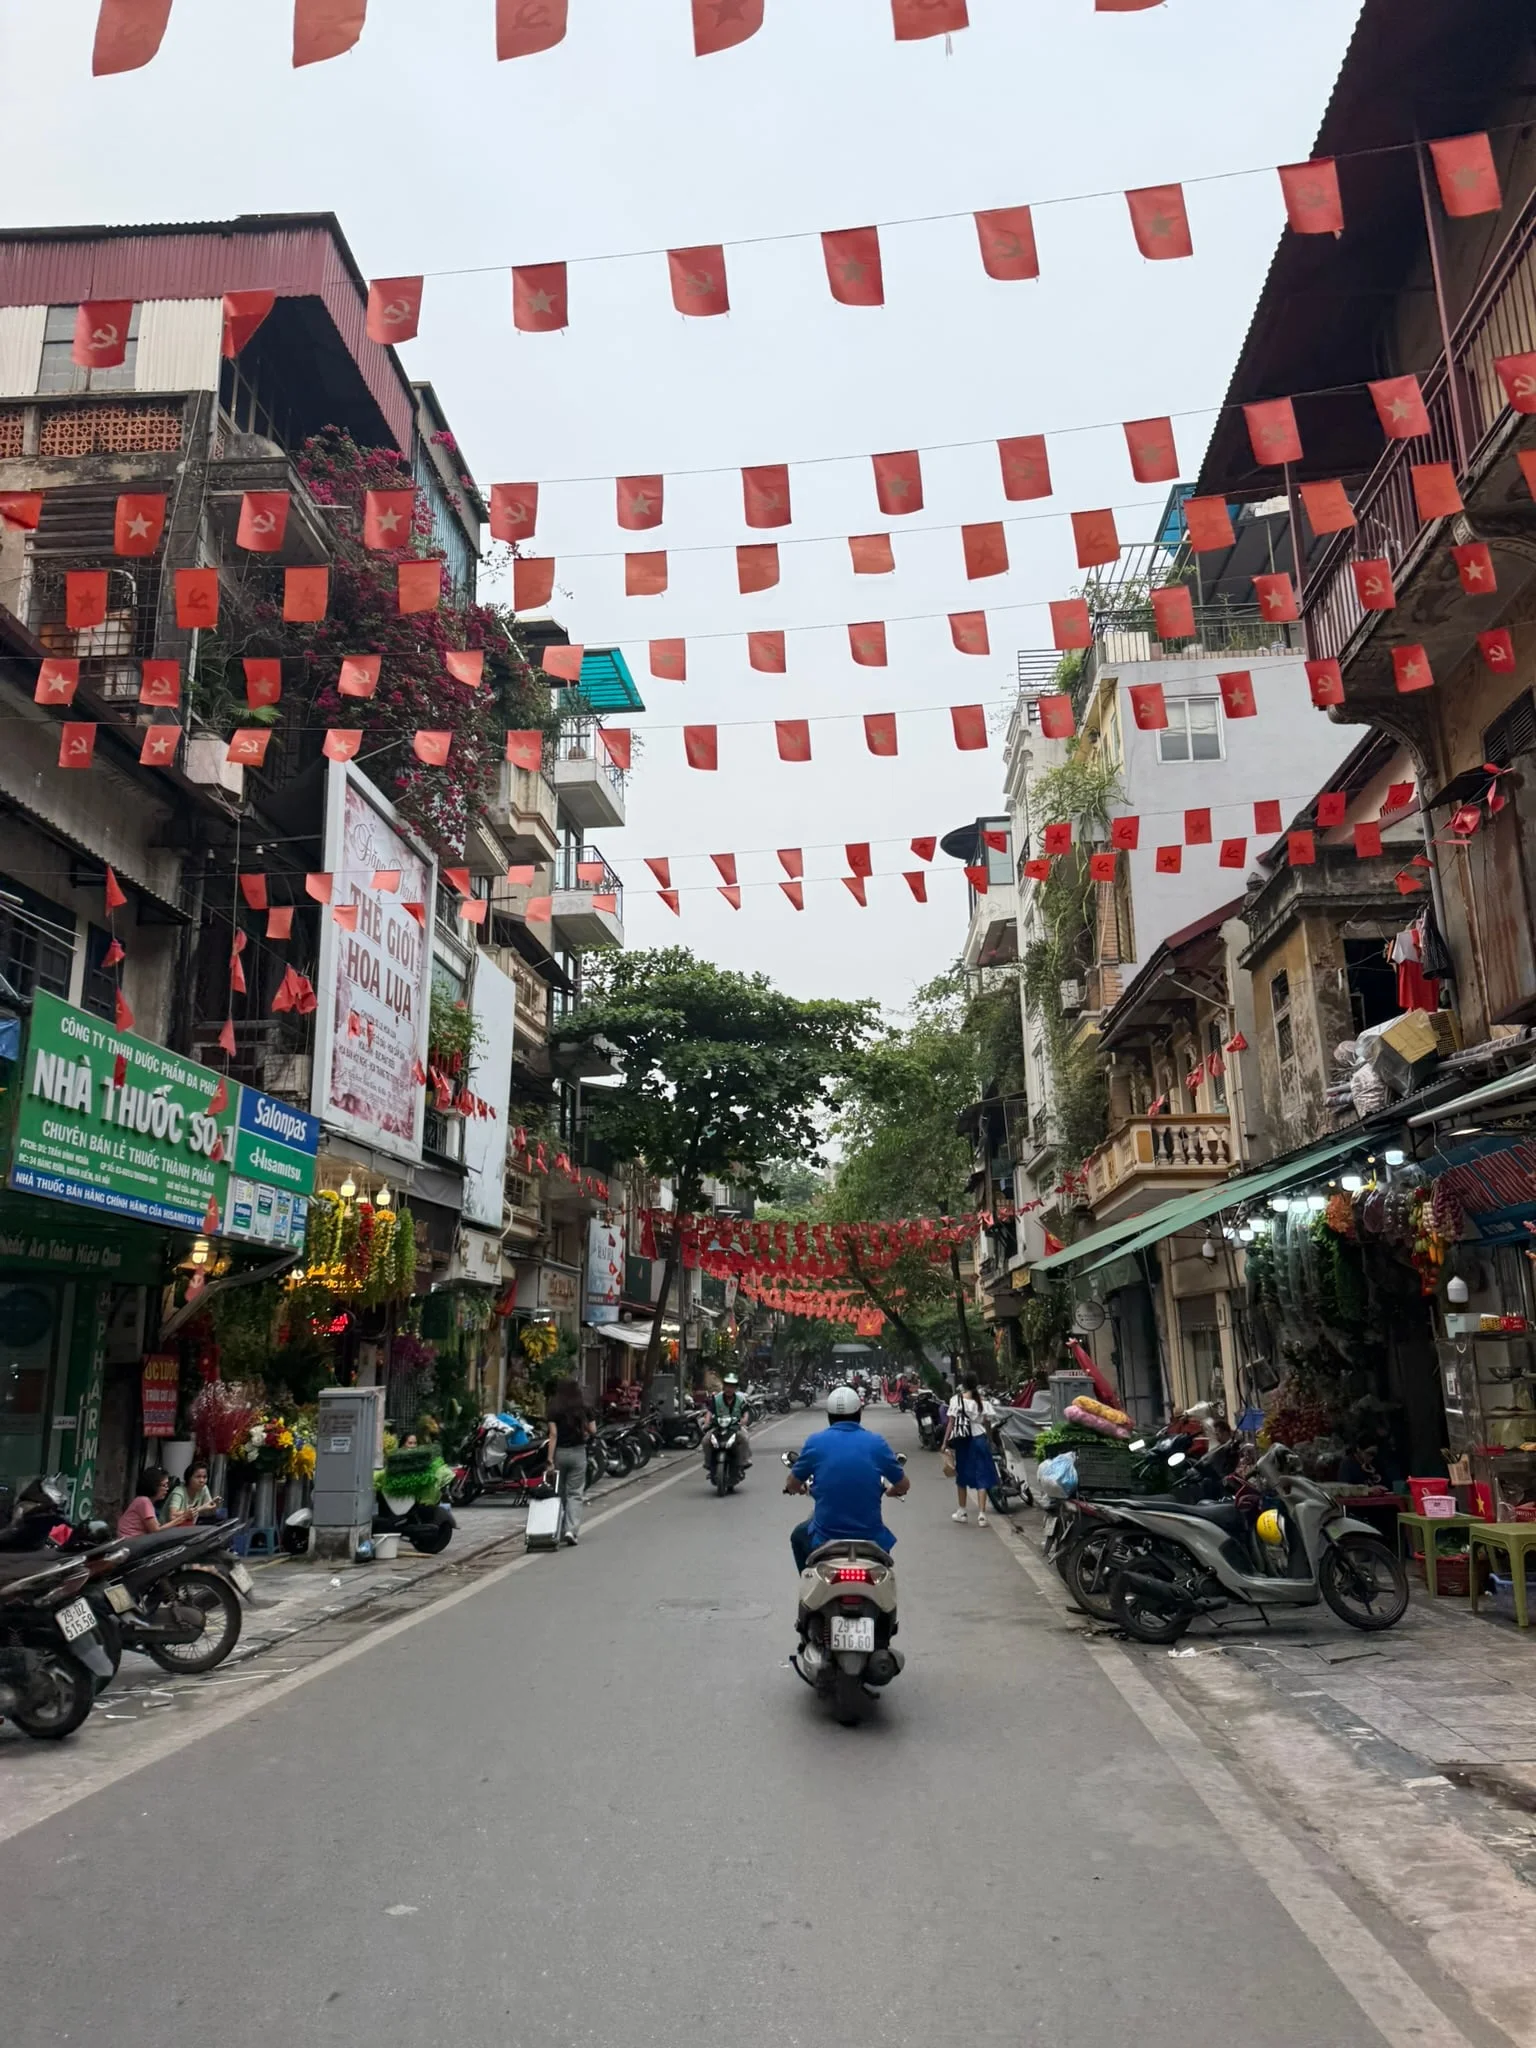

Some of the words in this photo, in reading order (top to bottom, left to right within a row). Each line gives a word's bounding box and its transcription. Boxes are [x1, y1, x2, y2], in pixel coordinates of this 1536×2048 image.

[387, 917, 415, 972] GIỚI
[346, 937, 381, 999] HOA
[385, 967, 412, 1026] LỤA
[61, 1016, 90, 1043] CÔNG
[92, 1030, 106, 1049] TY
[107, 1037, 133, 1061] TNHH
[135, 1049, 160, 1073] DƯỢC
[200, 1079, 219, 1097] PHÚ
[33, 1048, 91, 1114] NHÀ
[103, 1076, 184, 1143] THUỐC
[222, 1126, 236, 1162] 1
[254, 1097, 308, 1141] Salonpas
[42, 1120, 88, 1148] CHUYÊN
[89, 1135, 111, 1156] BÁN
[113, 1139, 127, 1160] LẺ
[129, 1147, 160, 1170] THUỐC
[161, 1156, 190, 1179] THÀNH
[250, 1146, 302, 1181] Hisamitsu
[15, 1172, 34, 1187] NHÀ
[36, 1177, 65, 1194] THUỐC
[66, 1184, 83, 1199] BÁN
[84, 1188, 105, 1204] HÀNG
[106, 1194, 128, 1209] CHÍNH
[149, 1204, 163, 1217] CỦA
[163, 1208, 196, 1225] HISAMITSU
[78, 1321, 107, 1521] PHARMAC
[65, 1612, 95, 1638] 515.58
